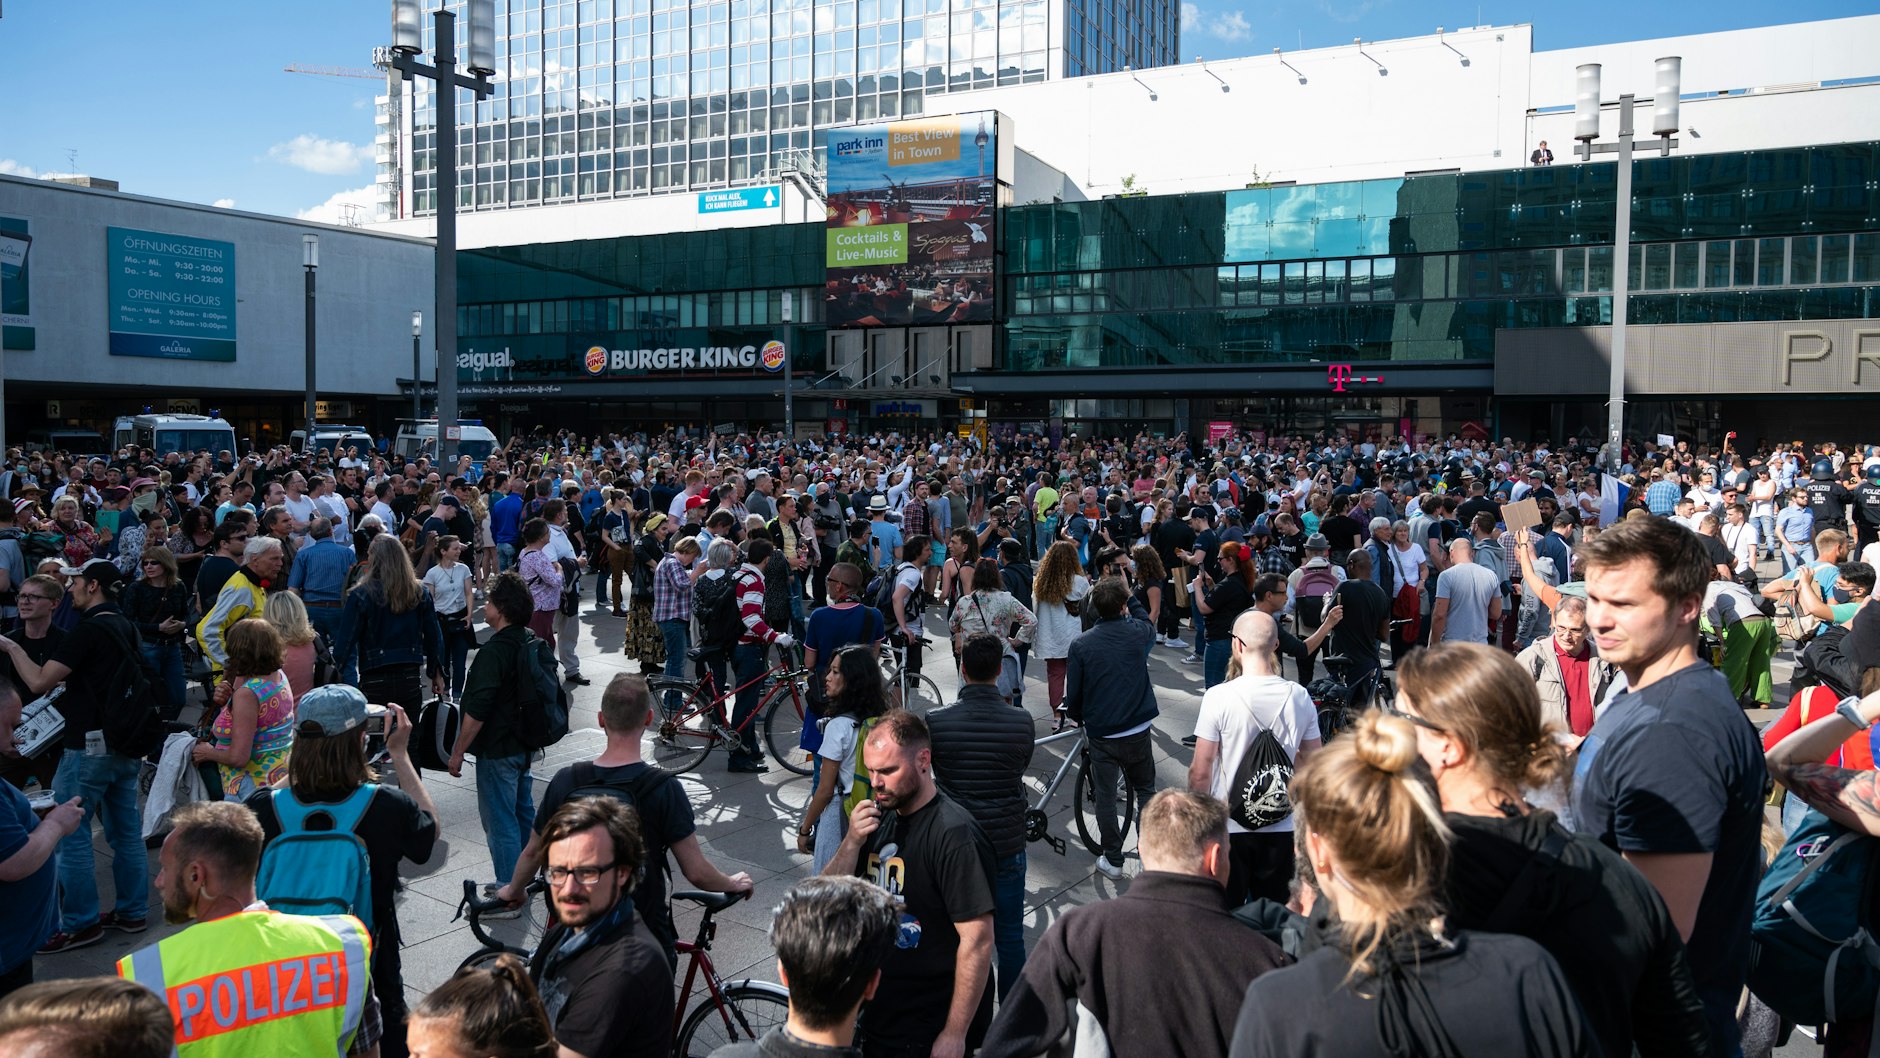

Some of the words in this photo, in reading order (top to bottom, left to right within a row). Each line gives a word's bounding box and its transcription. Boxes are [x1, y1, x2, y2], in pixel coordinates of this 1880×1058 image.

[893, 131, 919, 144] Best
[923, 128, 954, 140] View
[837, 138, 862, 155] park
[865, 137, 883, 148] inn
[893, 149, 904, 160] in
[908, 145, 942, 158] Town
[836, 231, 888, 246] Cocktails
[893, 231, 901, 241] &
[124, 236, 222, 258] ÖFFNUNGSZEITEN
[837, 246, 898, 261] Live-Music
[175, 261, 193, 270] 9:30
[201, 265, 223, 273] 20:00
[201, 275, 224, 284] 22:00
[128, 288, 180, 303] OPENING
[184, 294, 220, 306] HOURS
[169, 309, 195, 317] 9:30am
[586, 357, 605, 368] KING
[611, 348, 695, 370] BURGER
[700, 345, 756, 368] KING
[764, 350, 783, 364] KING
[177, 955, 340, 1038] POLIZEI
